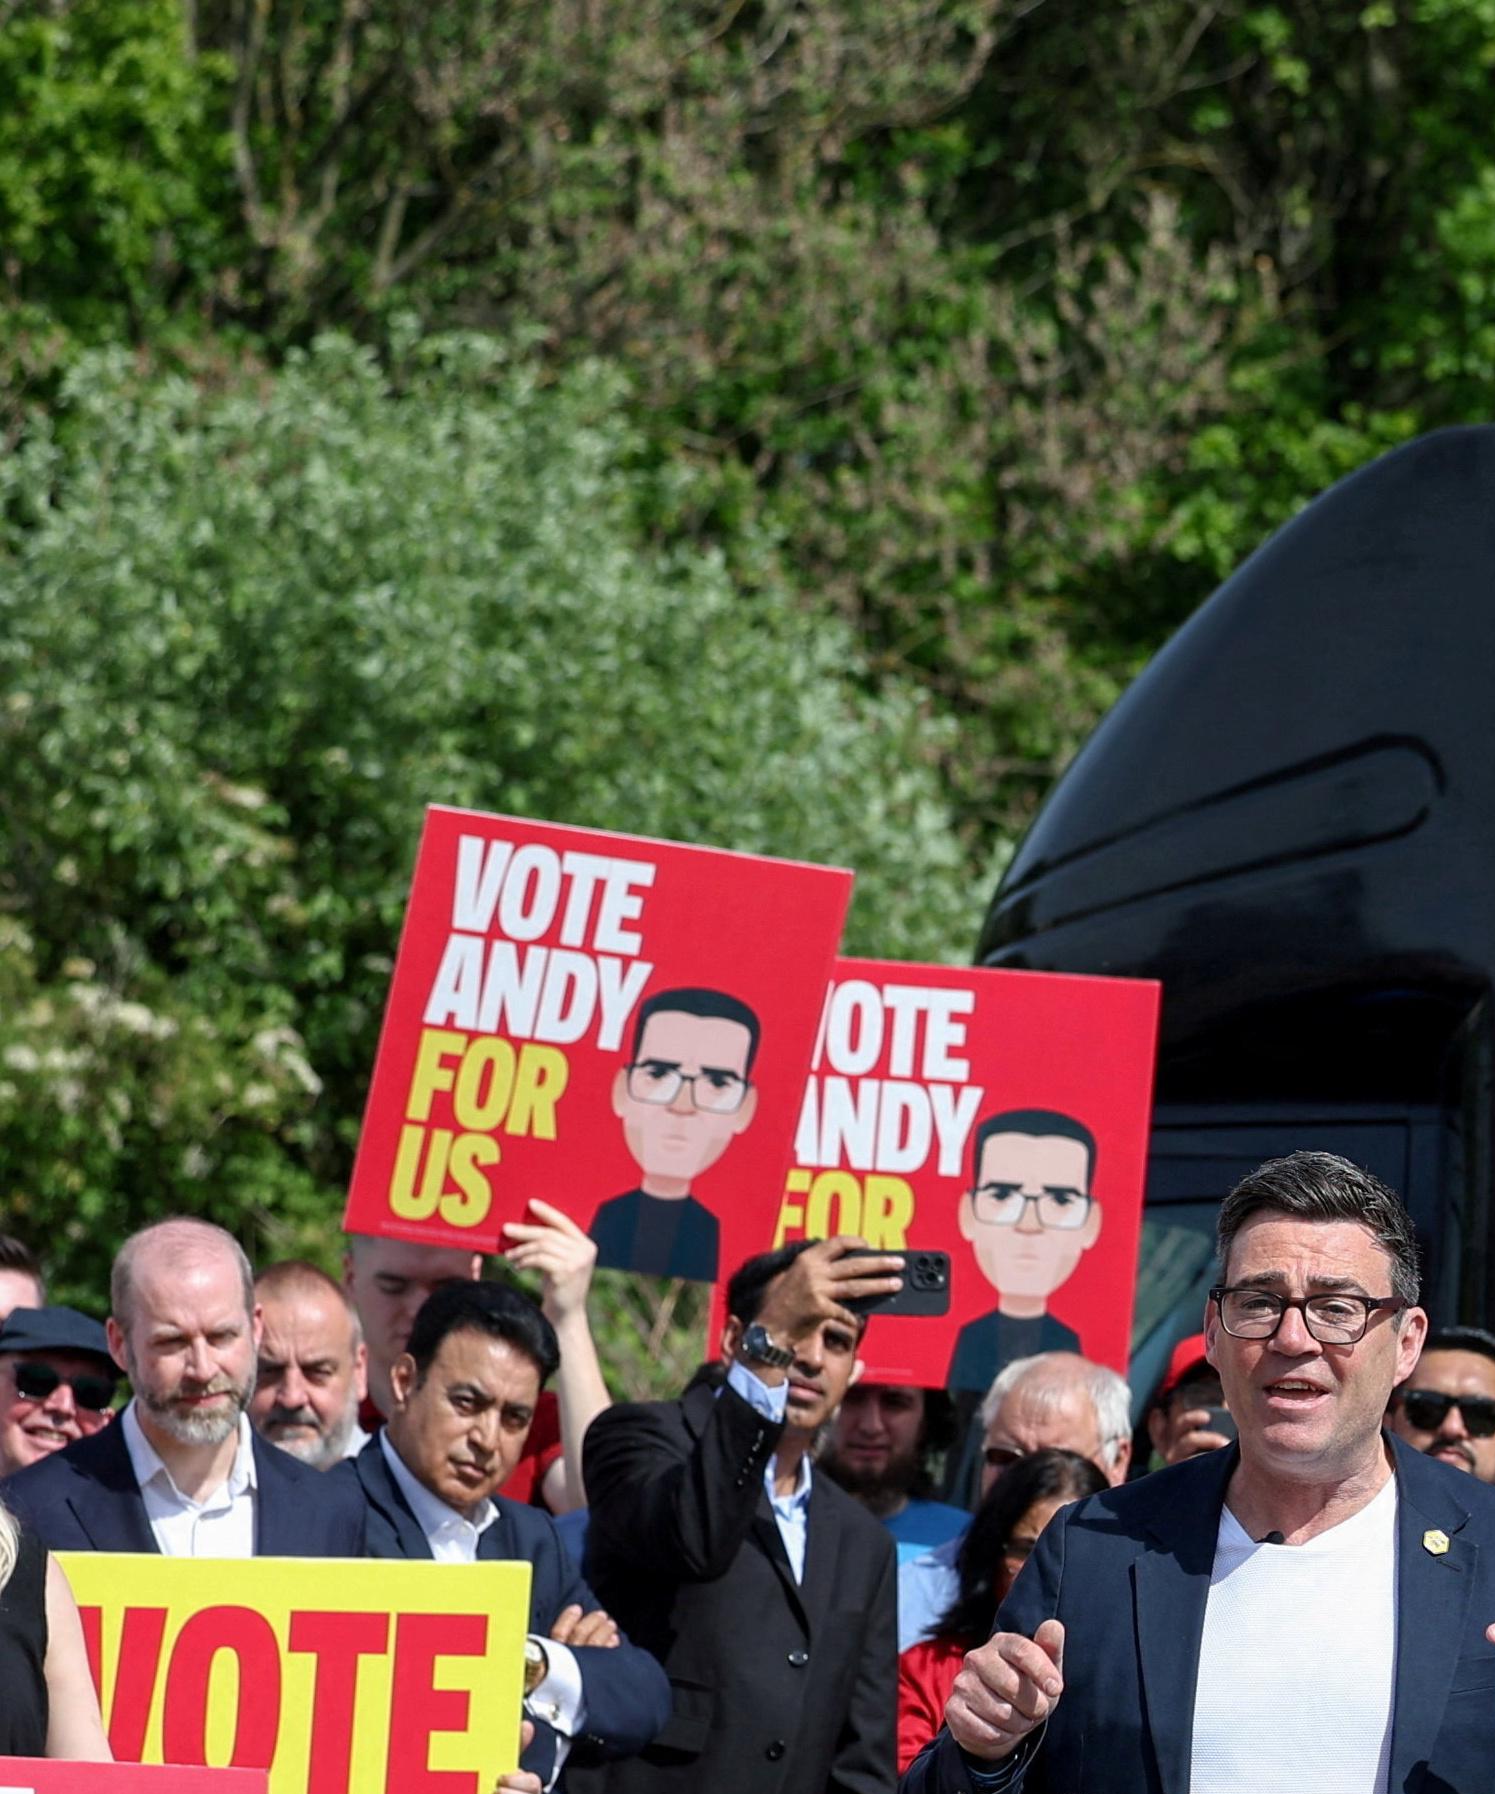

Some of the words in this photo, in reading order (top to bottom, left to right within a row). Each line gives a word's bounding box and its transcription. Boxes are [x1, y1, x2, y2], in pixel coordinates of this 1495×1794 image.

[454, 834, 655, 955] VOTE
[424, 934, 653, 1051] ANDY
[812, 979, 975, 1082] OTE
[406, 1028, 569, 1141] FOR
[794, 1075, 984, 1177] ANDY
[389, 1122, 500, 1227] US
